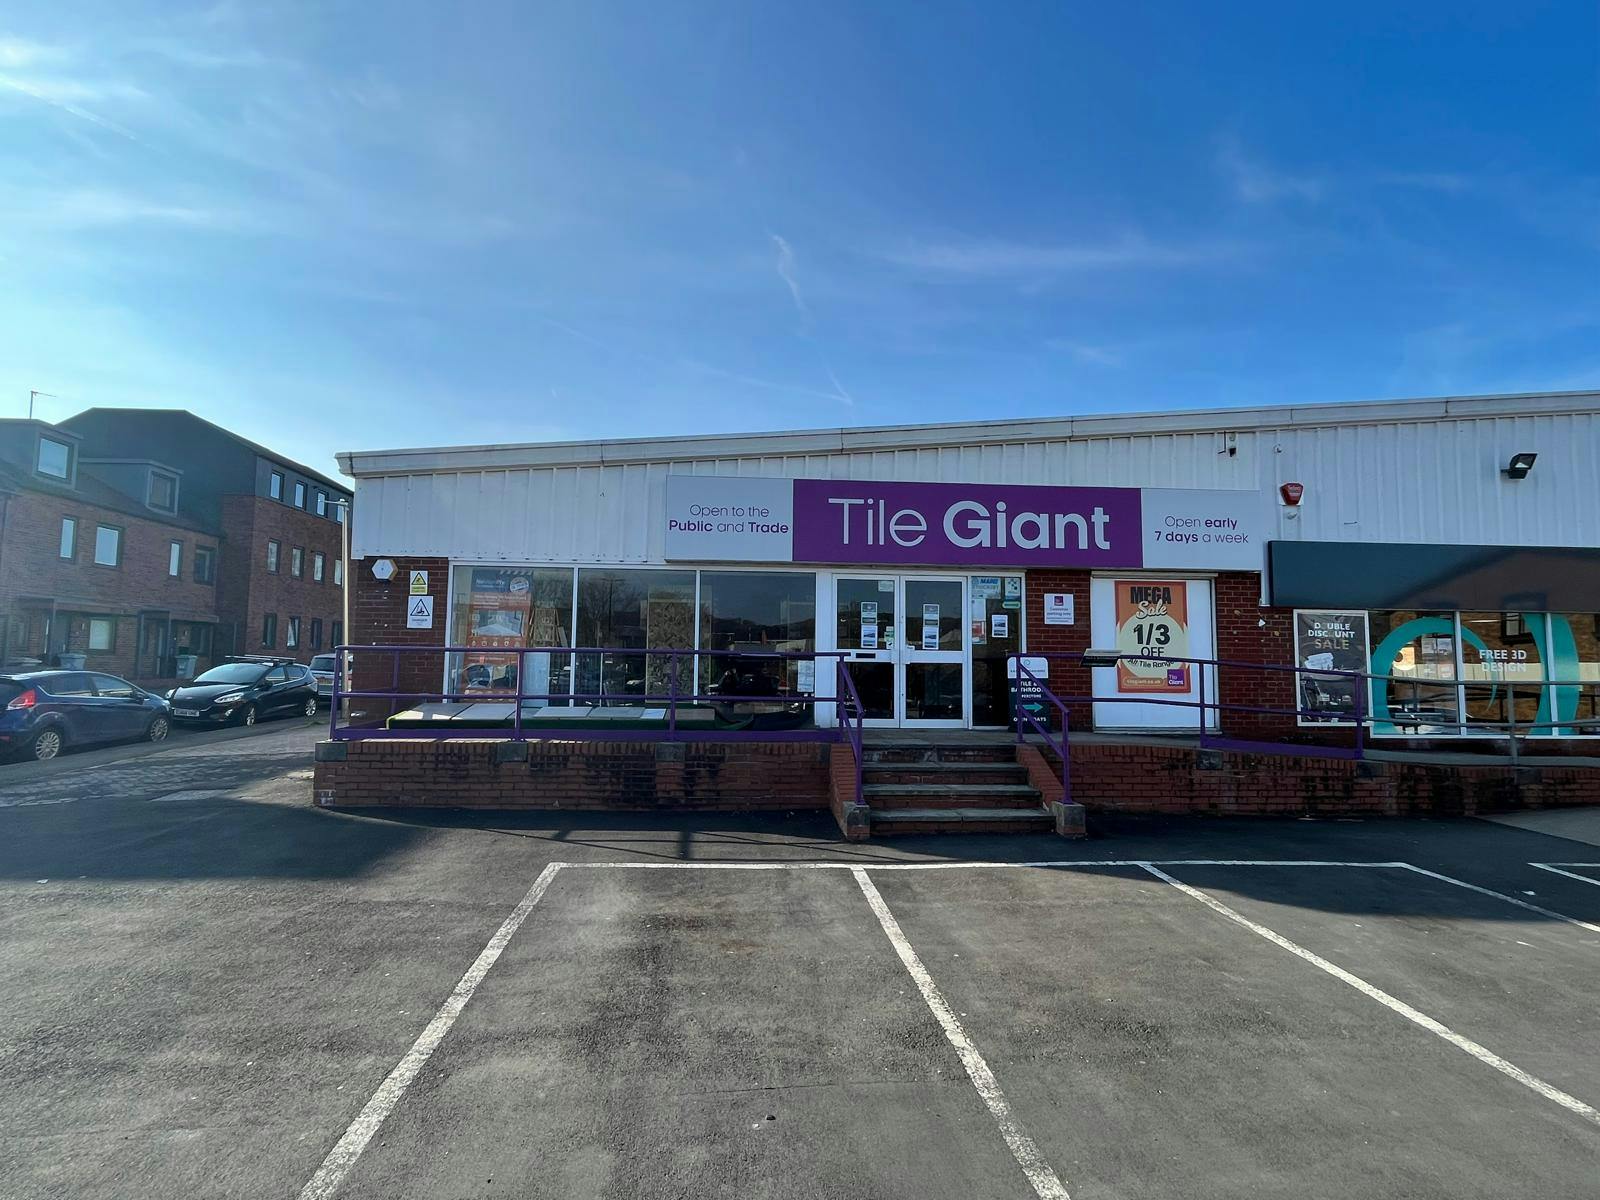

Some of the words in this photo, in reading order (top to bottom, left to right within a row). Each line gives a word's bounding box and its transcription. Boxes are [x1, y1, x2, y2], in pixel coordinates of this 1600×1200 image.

[689, 504, 728, 517] Open
[732, 506, 744, 517] to
[748, 506, 769, 518] the
[669, 520, 713, 532] Public
[716, 521, 744, 533] and
[748, 522, 789, 534] Trade
[828, 498, 927, 547] Tile
[943, 500, 1110, 550] Giant
[1164, 515, 1201, 528] Open
[1205, 517, 1237, 530] early
[1154, 531, 1161, 541] 7
[1165, 531, 1198, 544] days
[1202, 534, 1211, 543] a
[1214, 533, 1249, 543] week
[1130, 586, 1171, 604] MEGA
[1135, 599, 1167, 619] Sale
[1133, 623, 1171, 645] 1/3
[1314, 638, 1350, 650] SALE
[1141, 646, 1164, 657] OFF
[1479, 649, 1508, 659] FREE
[1511, 649, 1527, 659] 3D
[1481, 662, 1526, 672] DESIGN
